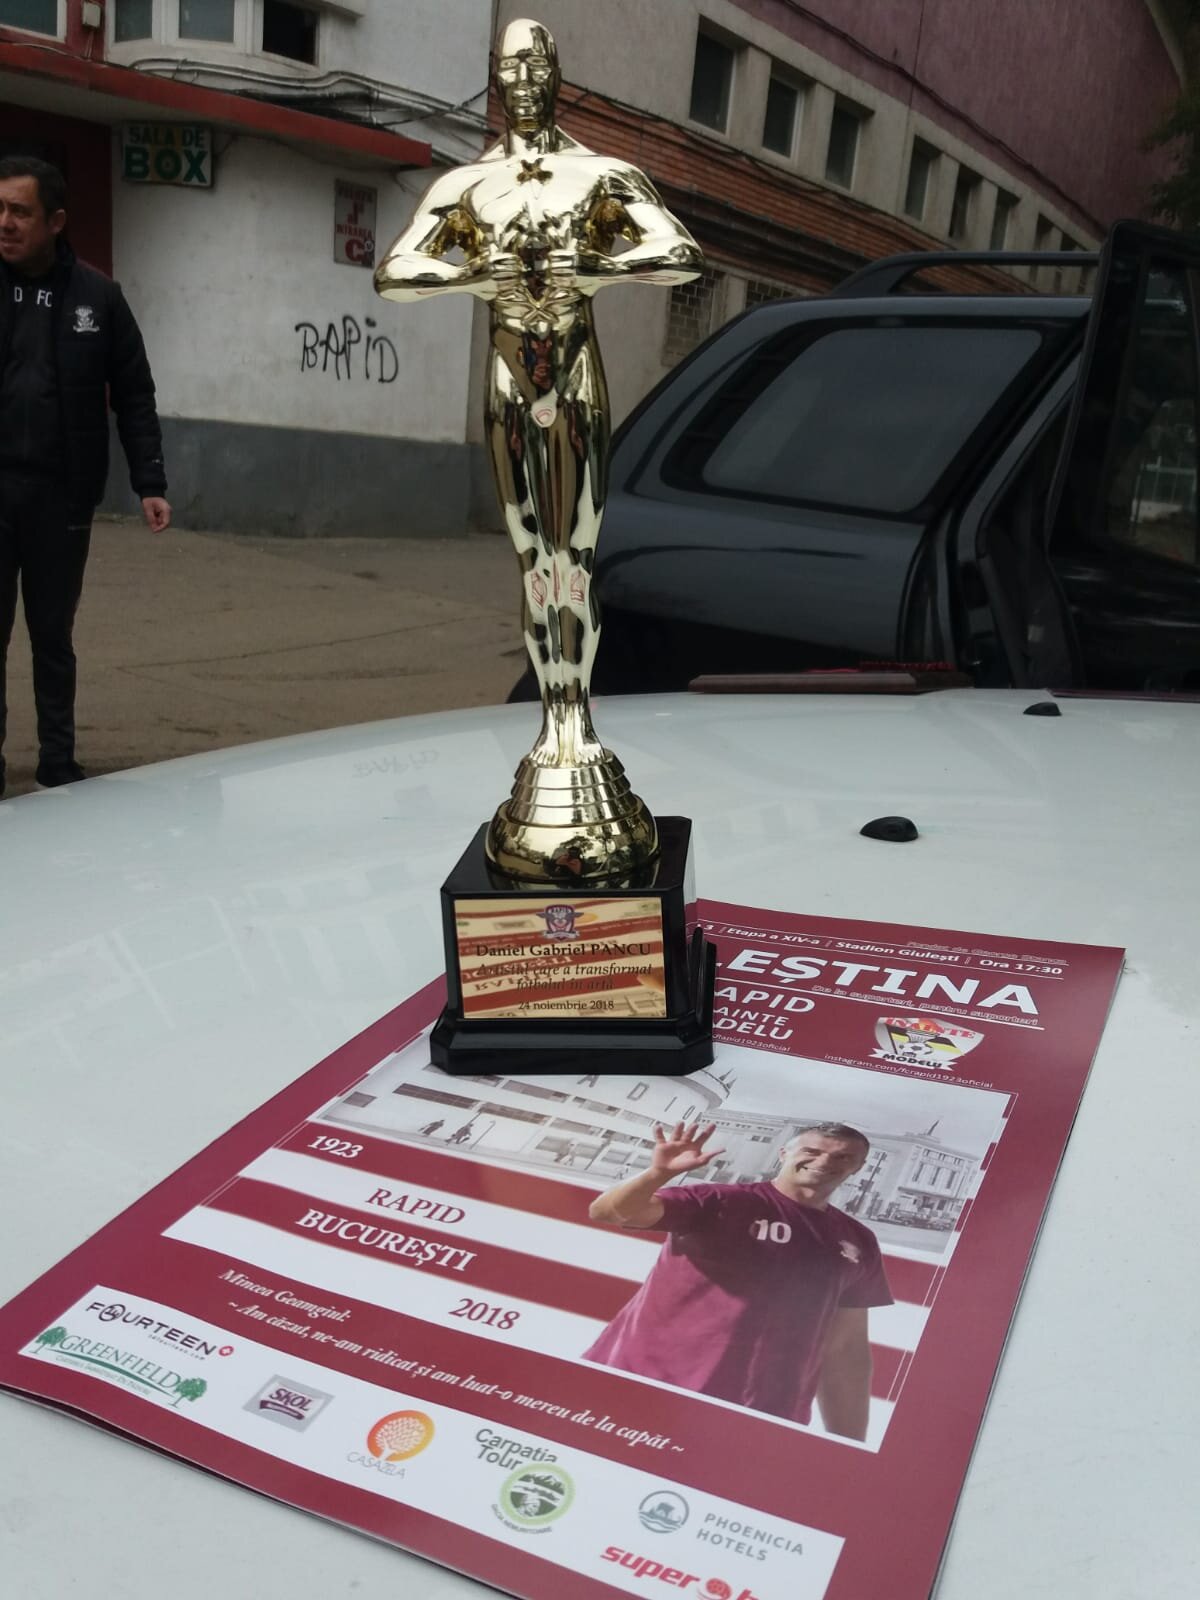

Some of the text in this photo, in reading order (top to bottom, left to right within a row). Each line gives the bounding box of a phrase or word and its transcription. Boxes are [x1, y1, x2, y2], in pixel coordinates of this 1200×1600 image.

[129, 127, 206, 148] SALA DE
[125, 144, 208, 184] BOX
[476, 943, 651, 957] Daniel Gabriel PANCU
[727, 926, 767, 939] Etapa
[768, 933, 779, 941] a
[782, 934, 821, 946] XIV-a
[835, 940, 895, 954] Stadion
[979, 958, 1010, 970] Ora
[1014, 964, 1063, 976] 17:30
[477, 961, 652, 977] Artistul care a transformat
[715, 949, 1039, 1015] EȘTINA
[518, 999, 615, 1011] 24 noiembrie 2018
[712, 1006, 790, 1027] AINTE
[713, 986, 816, 1013] APID
[711, 1017, 794, 1041] DELU
[307, 1135, 364, 1159] 1923
[365, 1187, 466, 1225] RAPID
[295, 1208, 478, 1272] BUCUREȘTI
[754, 1218, 793, 1244] 10
[85, 1301, 218, 1357] FOURTEEN
[449, 1297, 521, 1331] 2018
[58, 1334, 183, 1390] GREENFIELD
[236, 1304, 268, 1323] Am
[266, 1312, 309, 1338] căzut,
[311, 1330, 363, 1355] ne-am
[361, 1346, 419, 1372] ridicat
[431, 1370, 460, 1386] am
[458, 1374, 514, 1401] luat-o
[513, 1394, 570, 1420] mereu
[570, 1409, 597, 1427] de
[593, 1415, 617, 1434] la
[615, 1425, 672, 1451] capăt
[268, 1387, 313, 1412] SKOL
[475, 1428, 558, 1464] Carpatia
[476, 1444, 523, 1471] Tour
[695, 1528, 769, 1562] HOTELS
[703, 1512, 805, 1556] PHOENICIA
